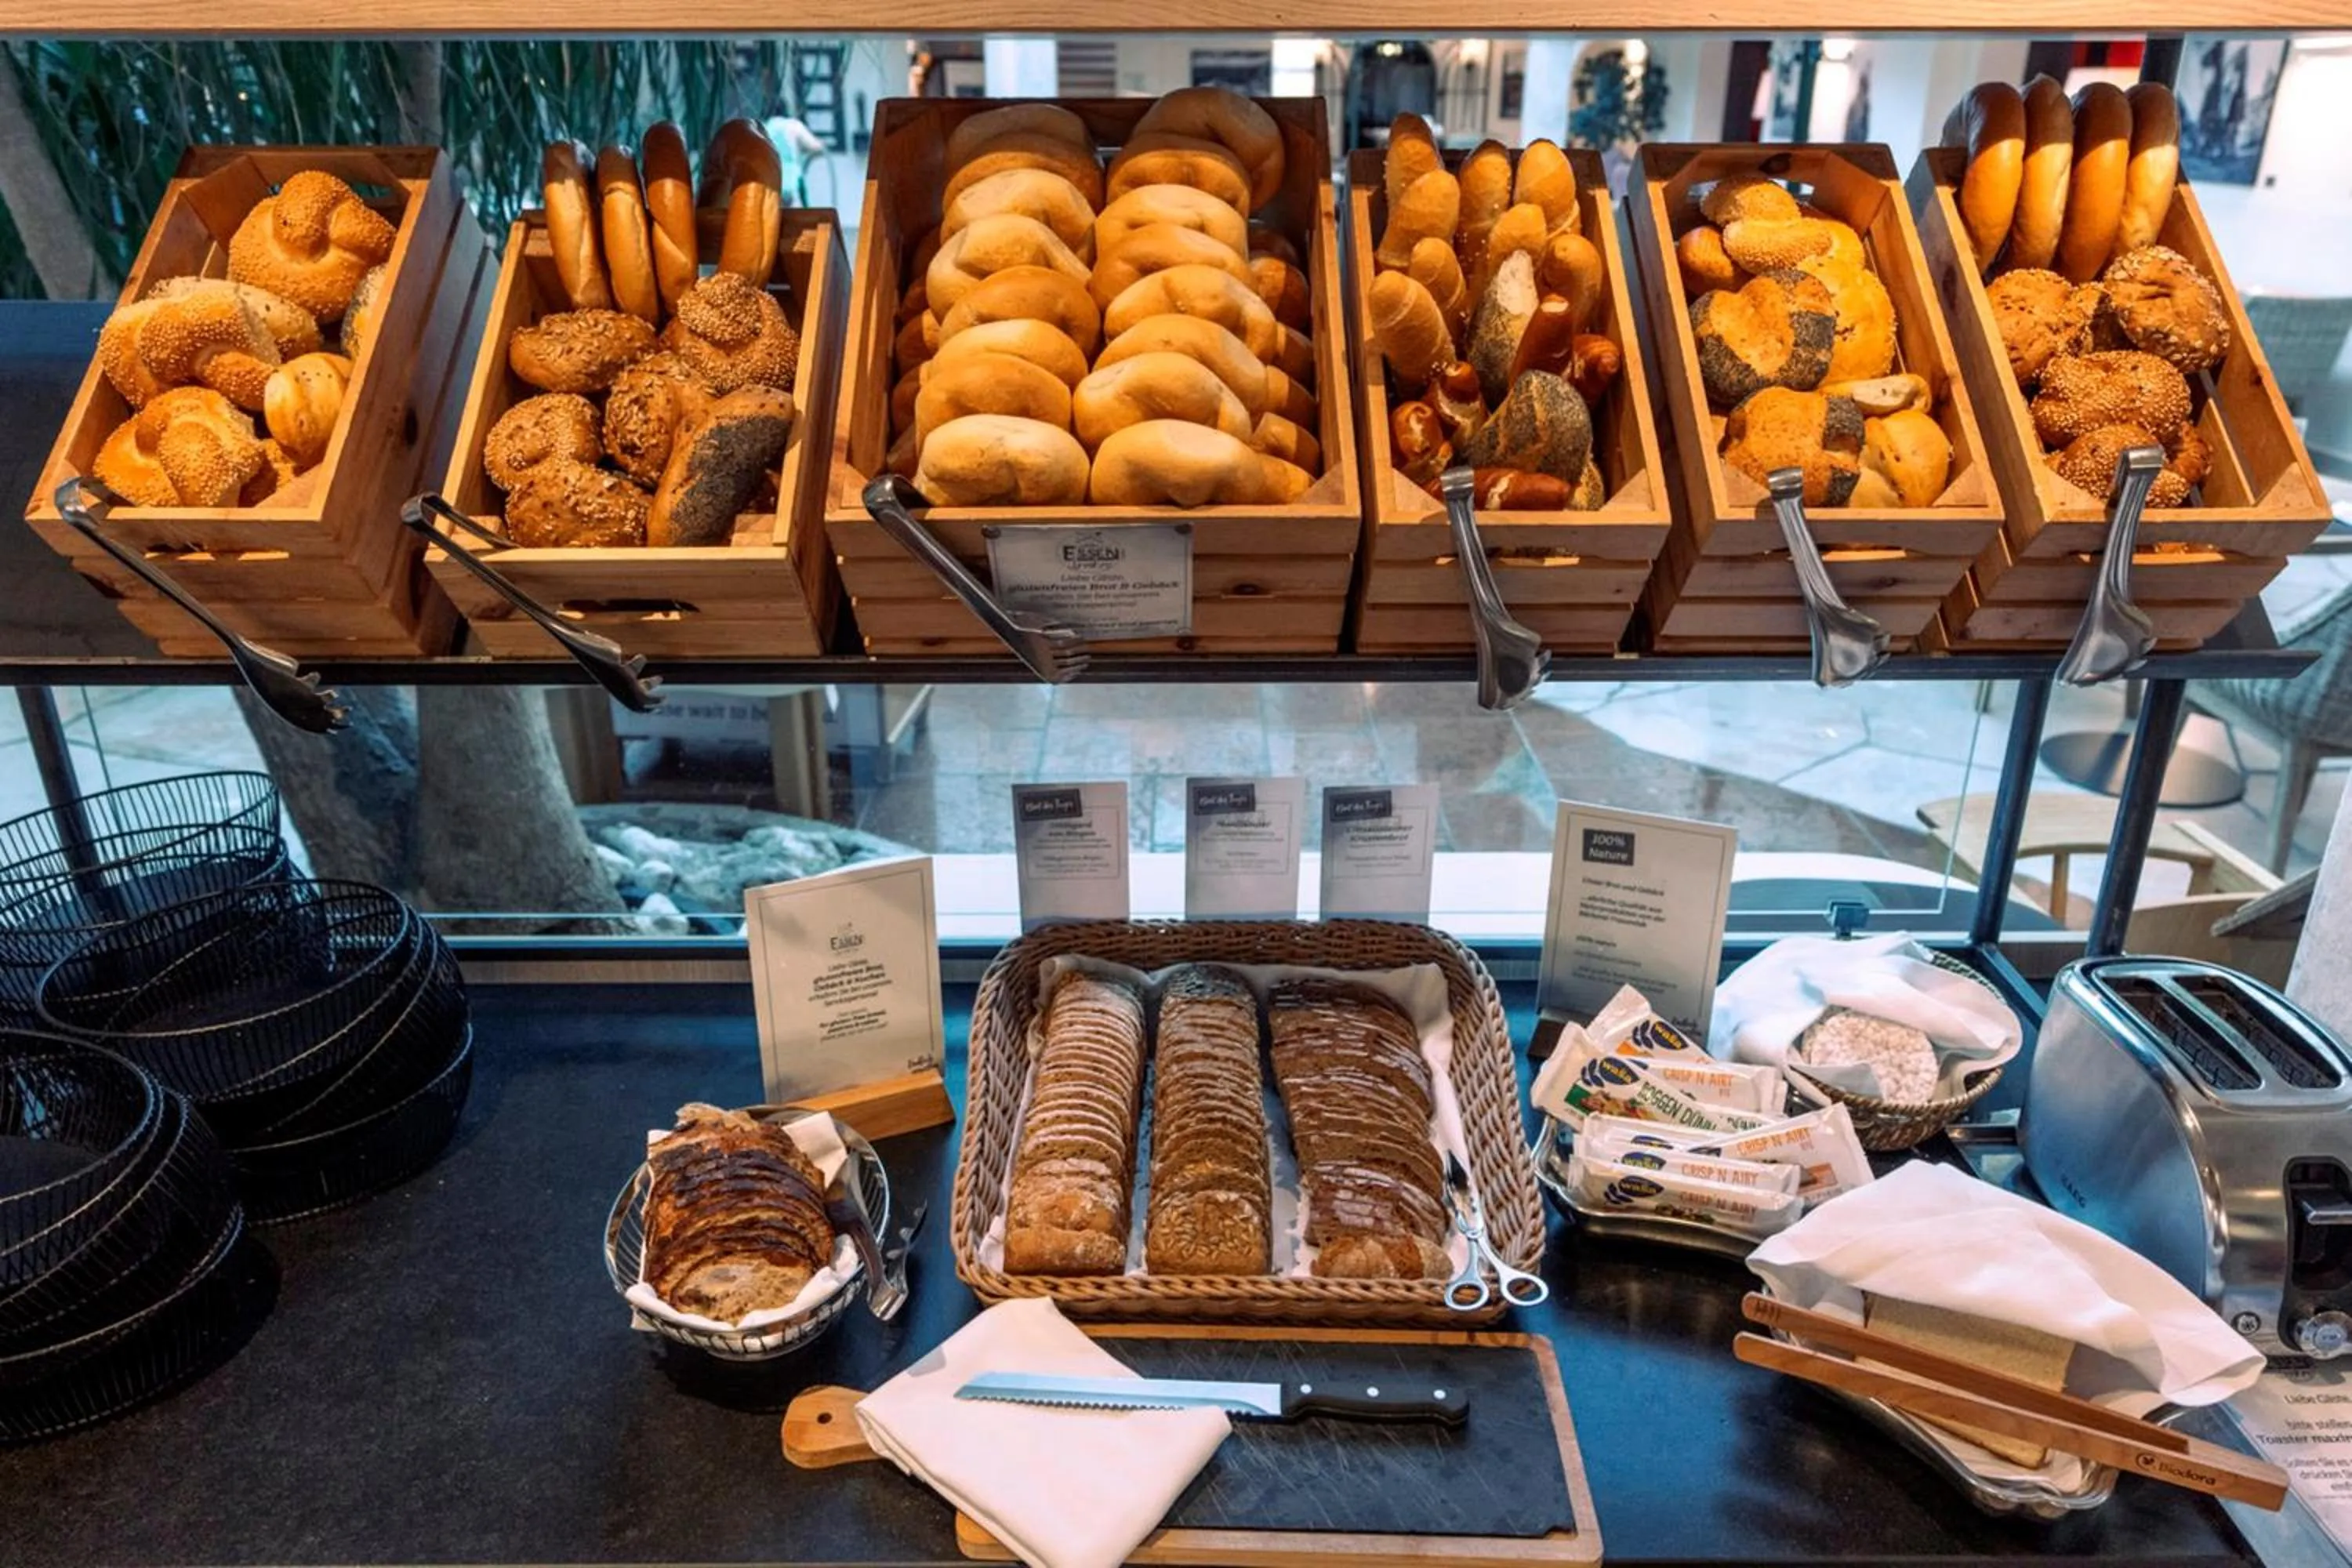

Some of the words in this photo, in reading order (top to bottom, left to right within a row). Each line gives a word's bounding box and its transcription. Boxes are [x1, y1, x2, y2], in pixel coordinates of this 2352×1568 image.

[1063, 546, 1120, 562] ESSEN
[1592, 833, 1626, 848] 100%
[1589, 848, 1628, 862] Nature
[1637, 1080, 1683, 1118] ROGGEN
[1731, 1170, 1759, 1186] AIRY
[2256, 1435, 2308, 1444] Toaster
[2159, 1462, 2216, 1486] Biodora
